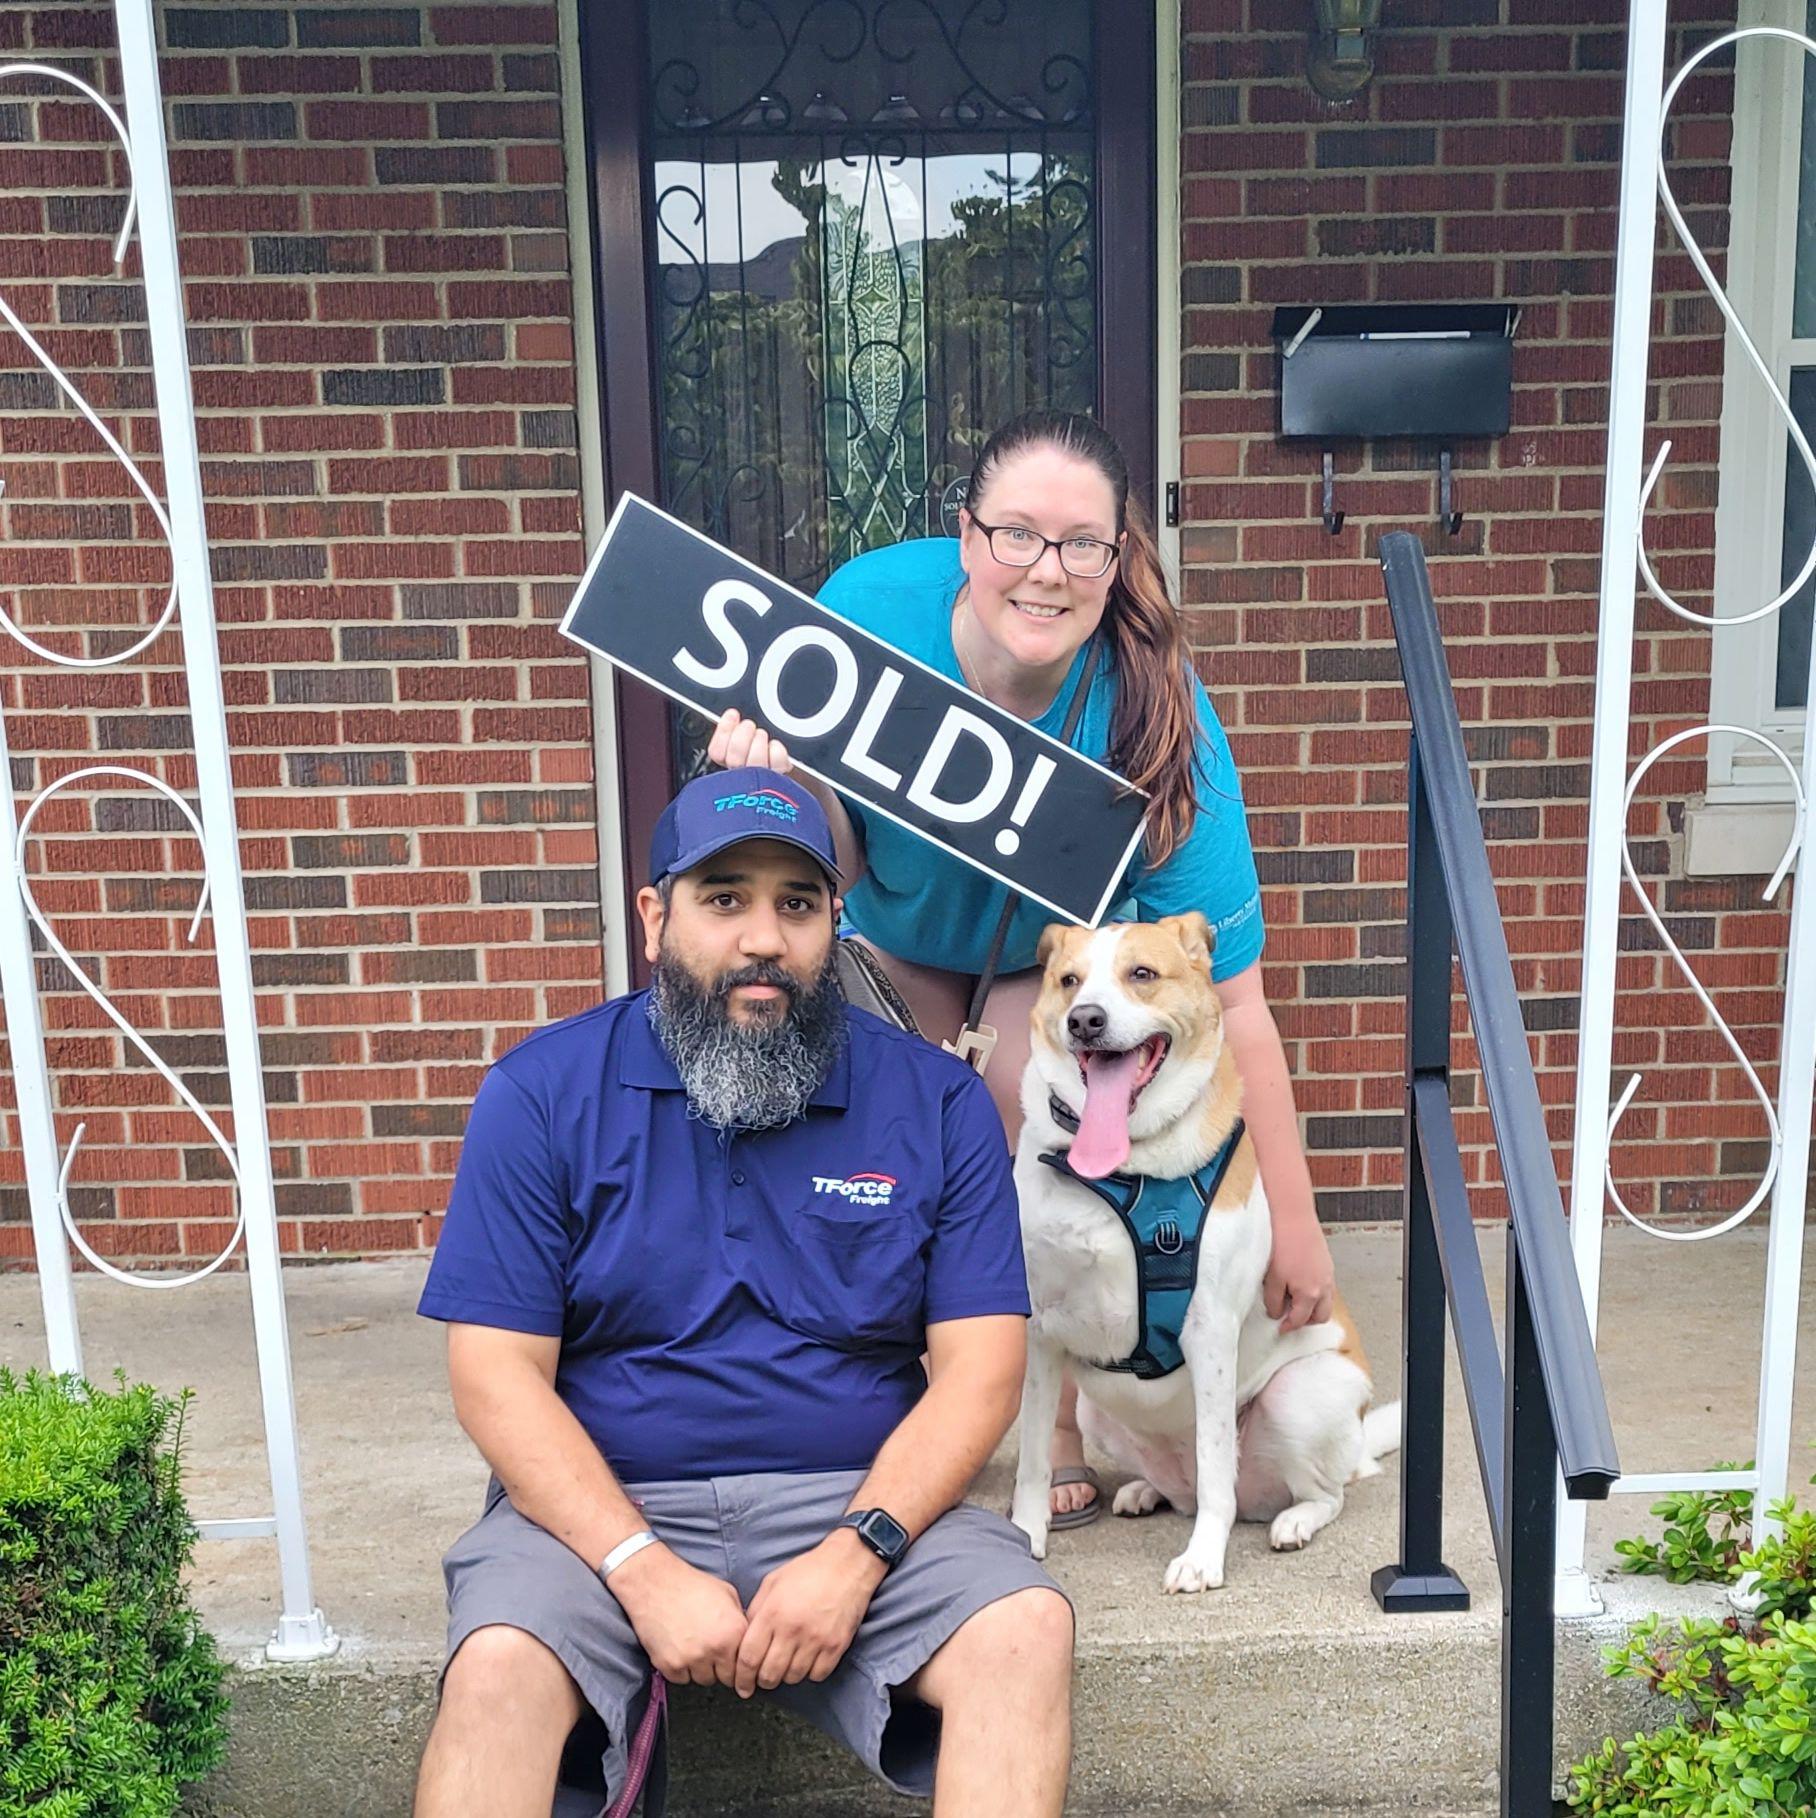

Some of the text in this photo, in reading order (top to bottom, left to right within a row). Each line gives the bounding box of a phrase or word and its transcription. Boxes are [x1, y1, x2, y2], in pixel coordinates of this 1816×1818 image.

[672, 579, 1057, 856] SOLD!
[714, 794, 798, 815] TForce
[756, 806, 797, 823] Freight
[812, 1176, 893, 1196] TForce
[849, 1195, 890, 1206] Freight
